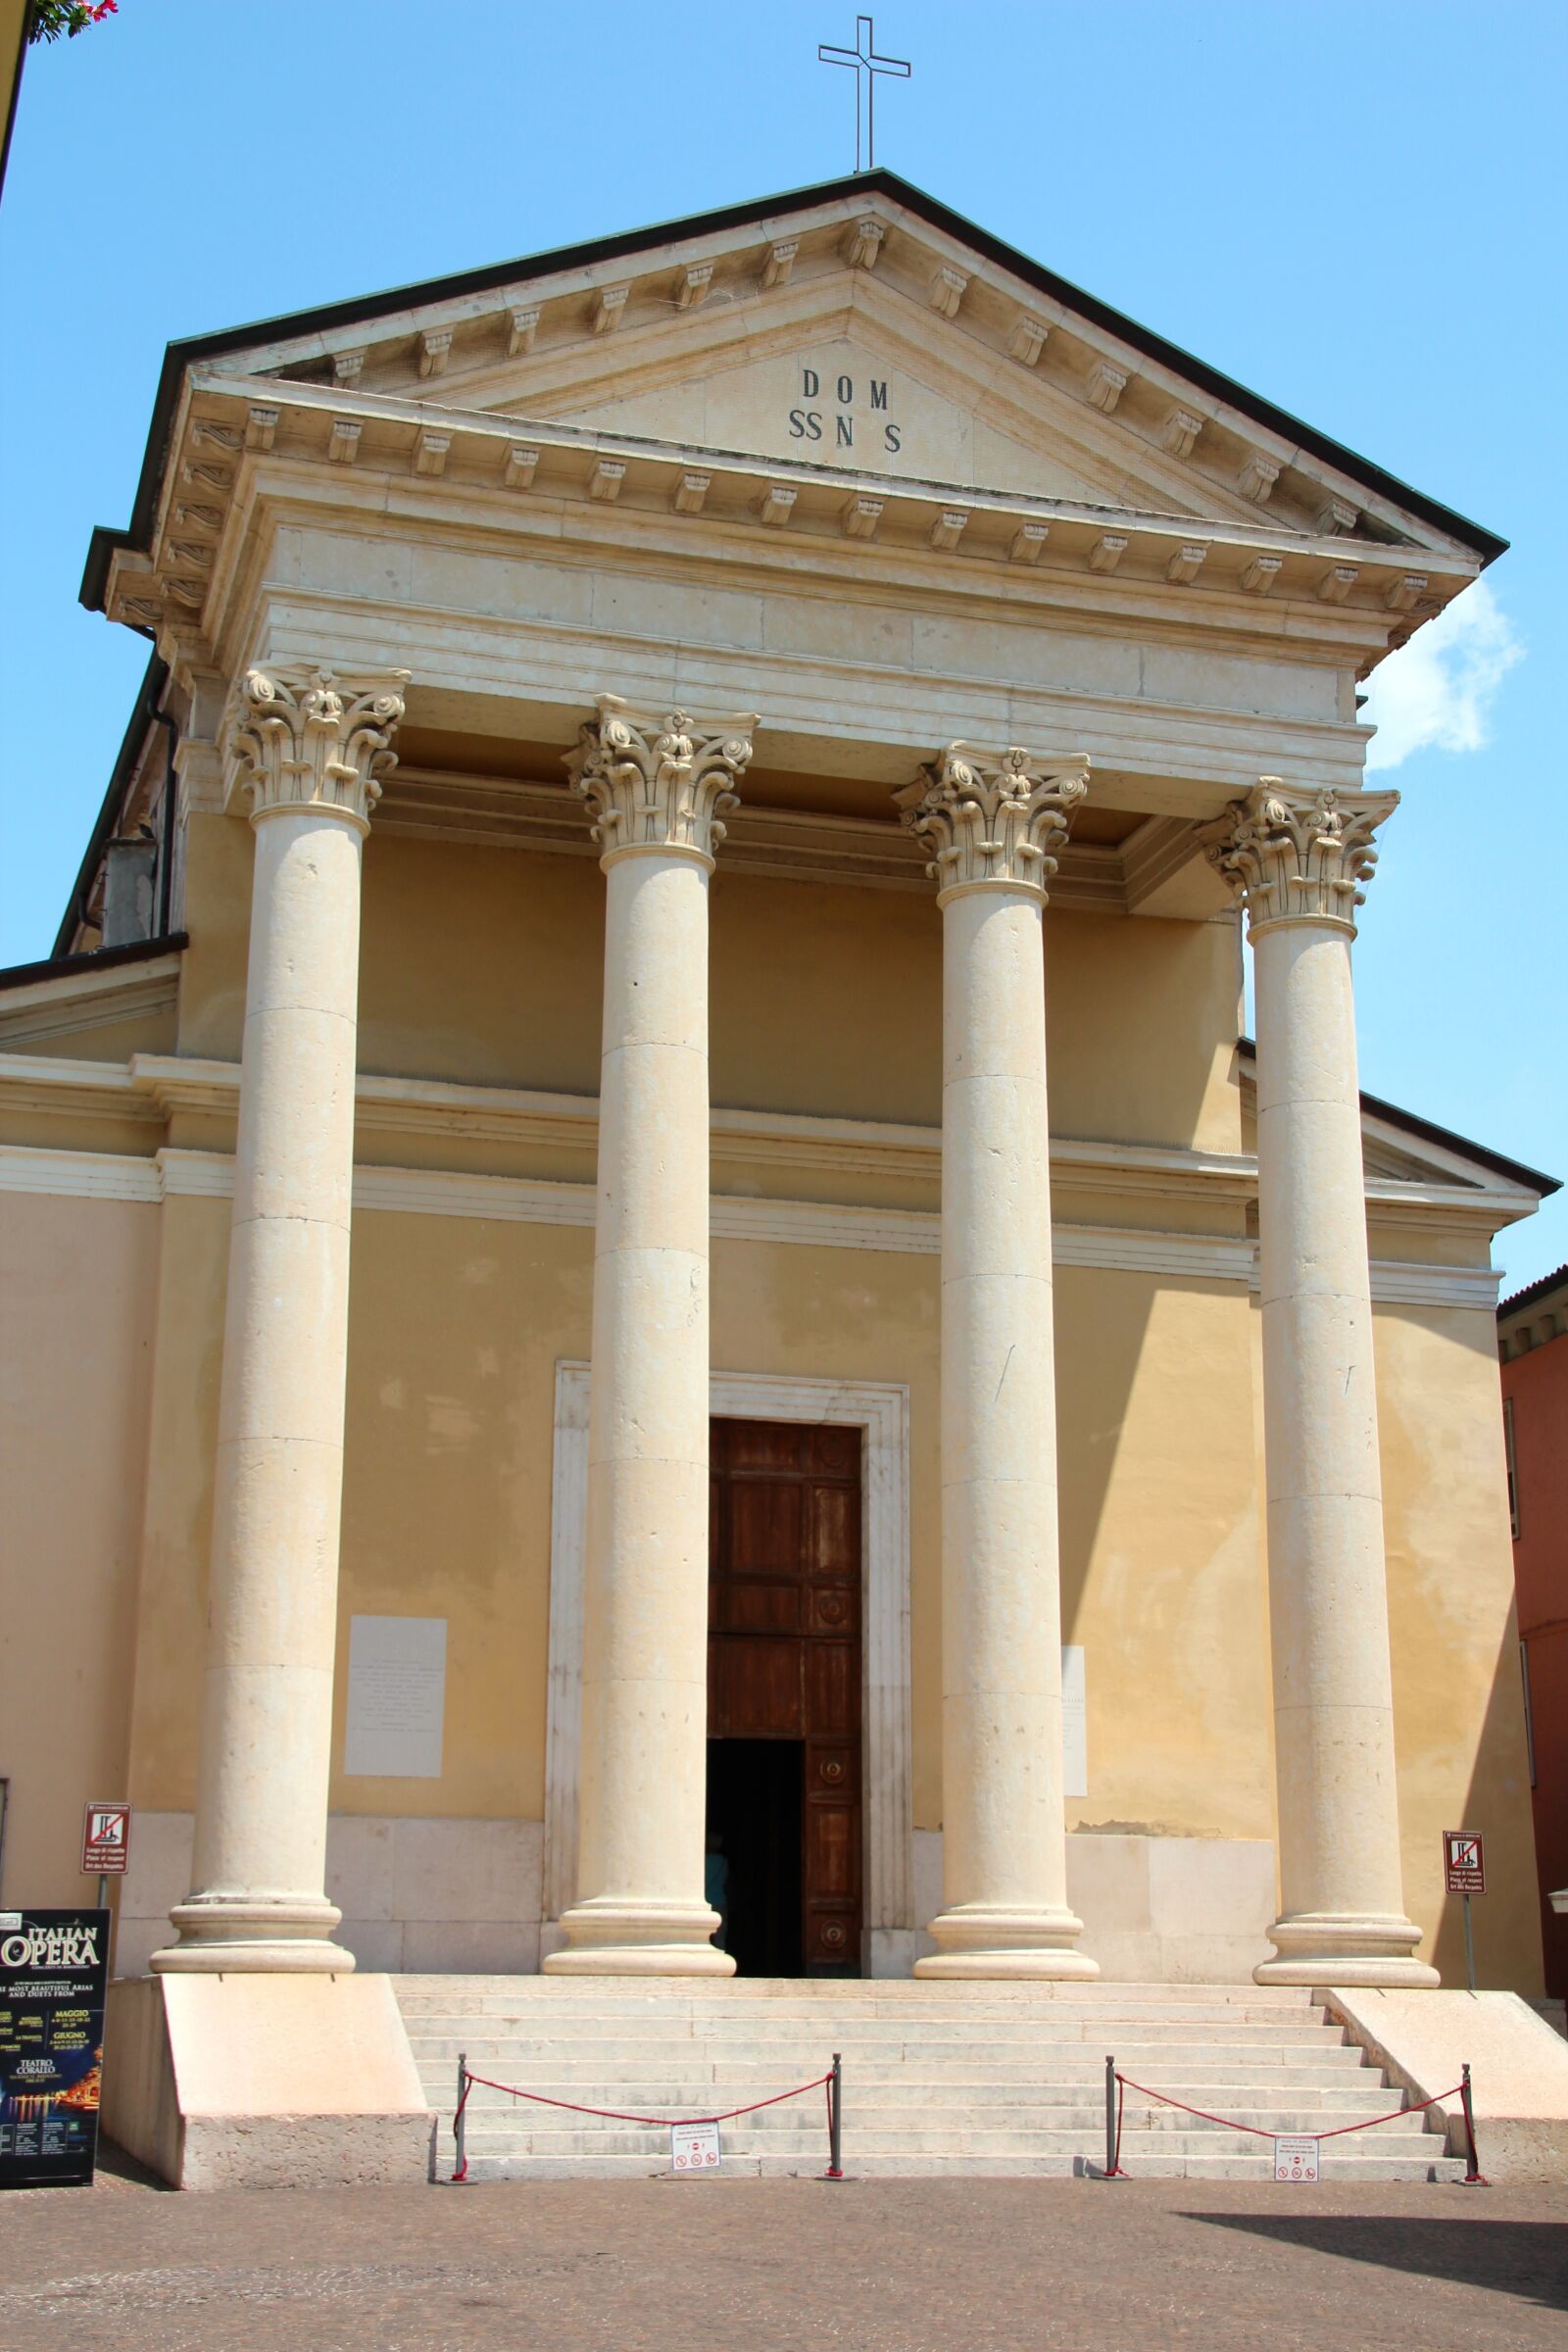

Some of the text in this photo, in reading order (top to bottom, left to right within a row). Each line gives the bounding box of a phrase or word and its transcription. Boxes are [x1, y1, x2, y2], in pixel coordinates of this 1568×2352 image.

[27, 1927, 98, 1940] ITALIAN
[1, 1936, 100, 1967] OPERA
[53, 2031, 86, 2039] GIUGNO
[16, 2066, 56, 2075] CORALLO
